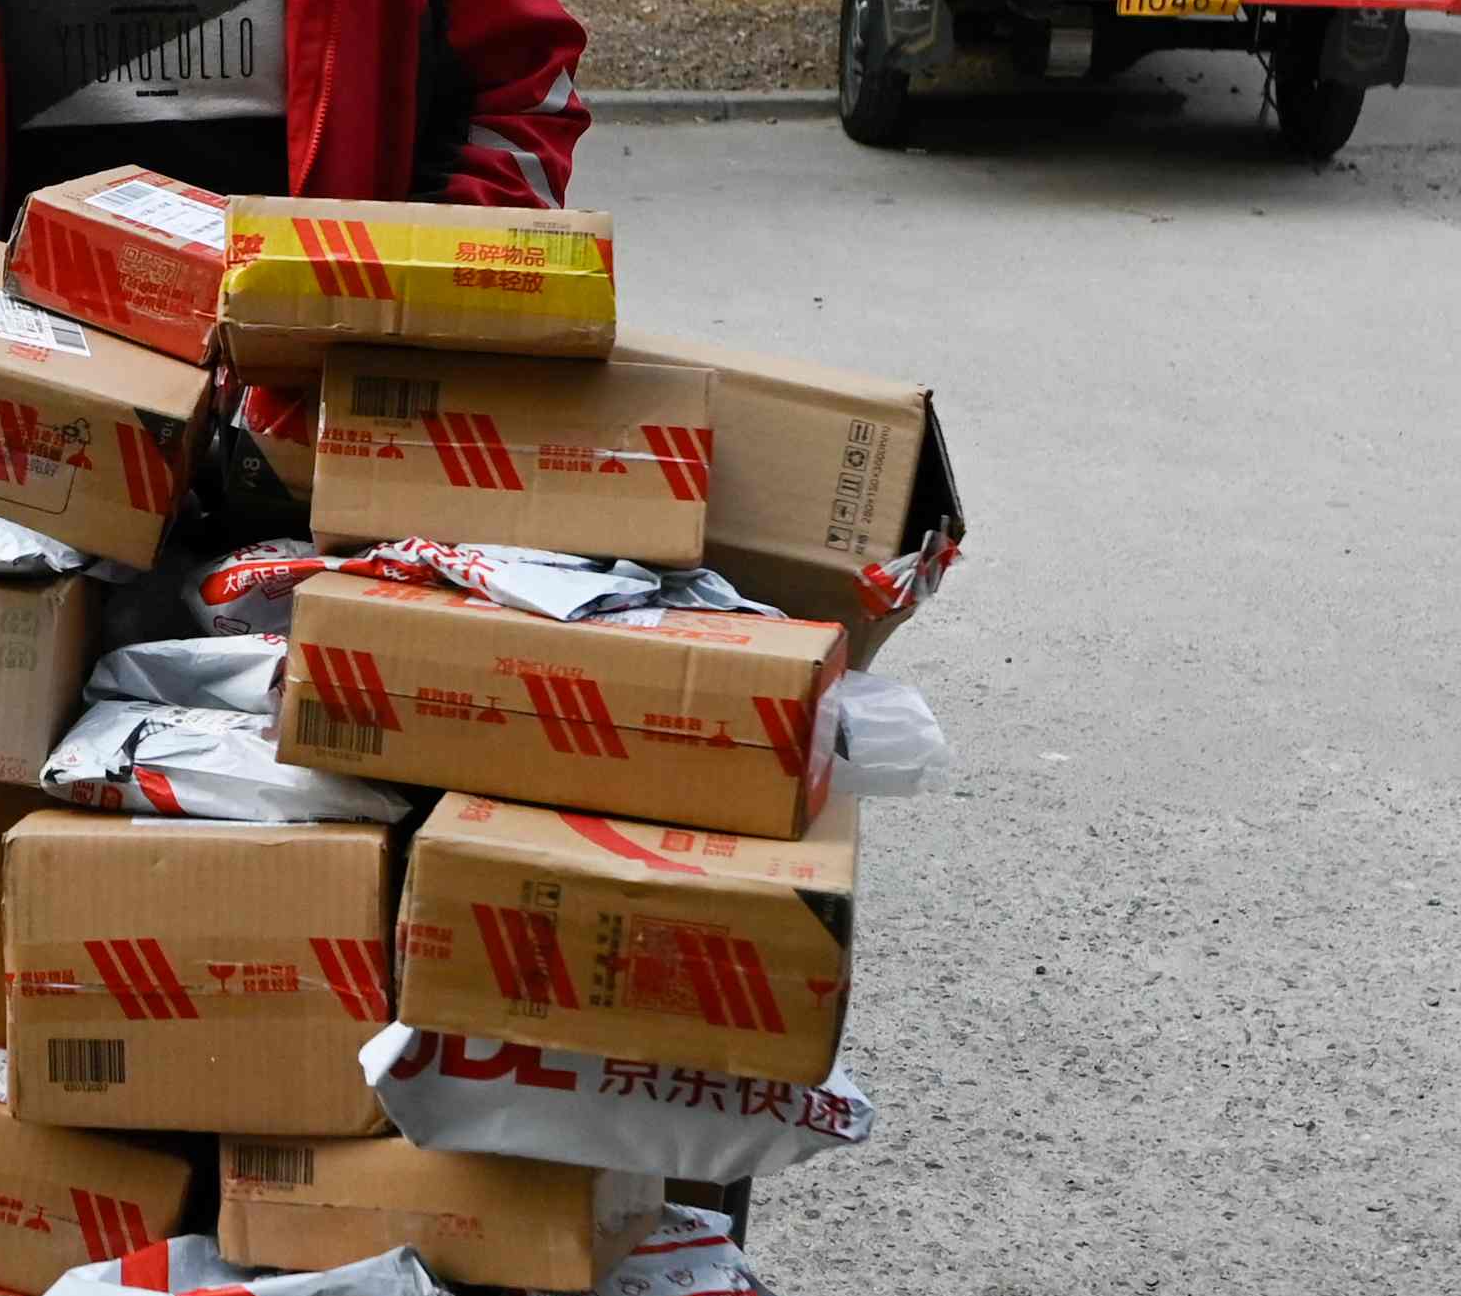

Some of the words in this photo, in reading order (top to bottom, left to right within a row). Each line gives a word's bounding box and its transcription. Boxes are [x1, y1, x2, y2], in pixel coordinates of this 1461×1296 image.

[453, 241, 547, 269] 易碎物品
[452, 266, 545, 295] 轻拿轻放
[598, 1056, 855, 1138] 京东快递
